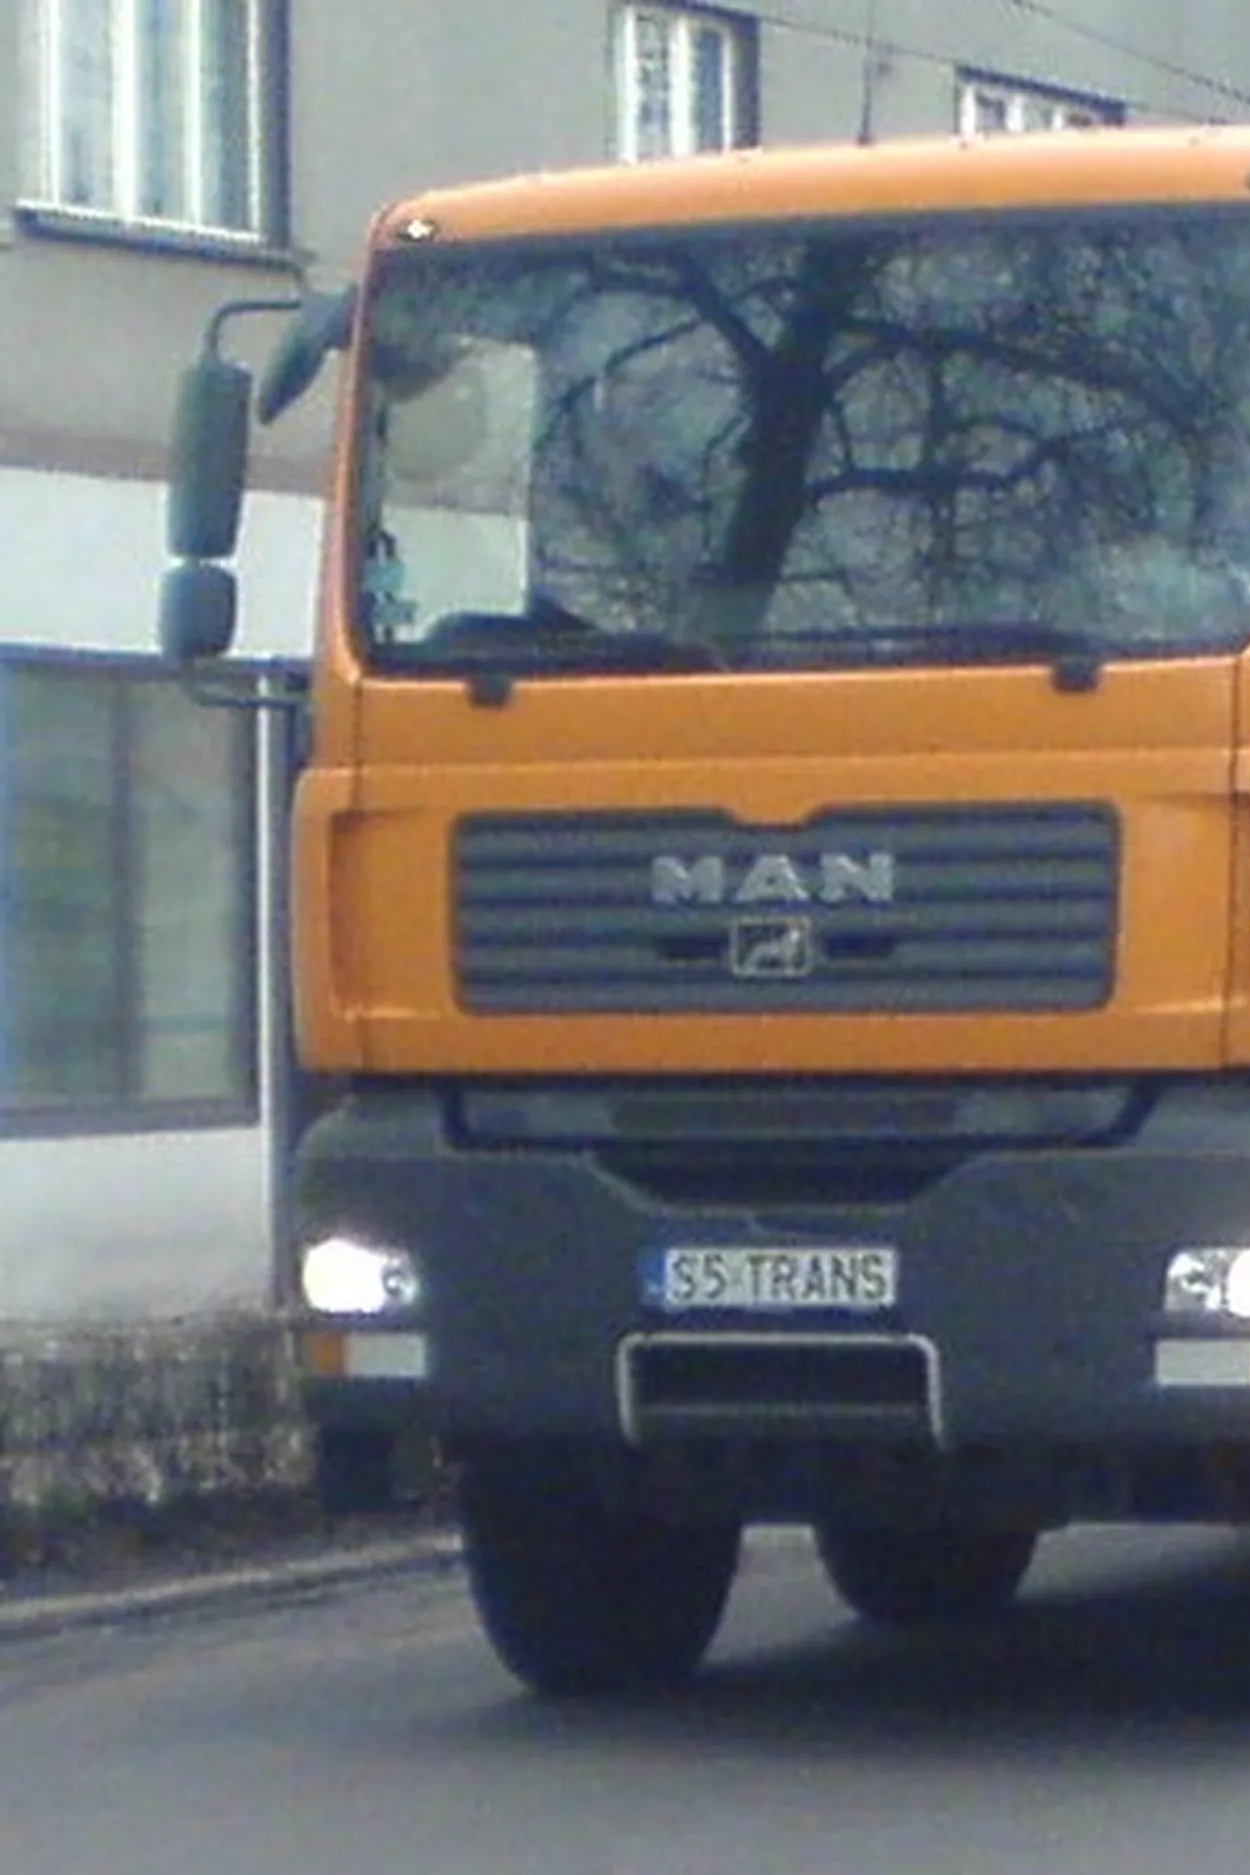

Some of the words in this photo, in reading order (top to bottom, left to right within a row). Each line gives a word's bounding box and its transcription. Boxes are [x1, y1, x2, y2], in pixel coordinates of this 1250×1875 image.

[652, 852, 895, 903] MAN
[671, 1253, 726, 1300] S5
[746, 1253, 887, 1300] TRANS
